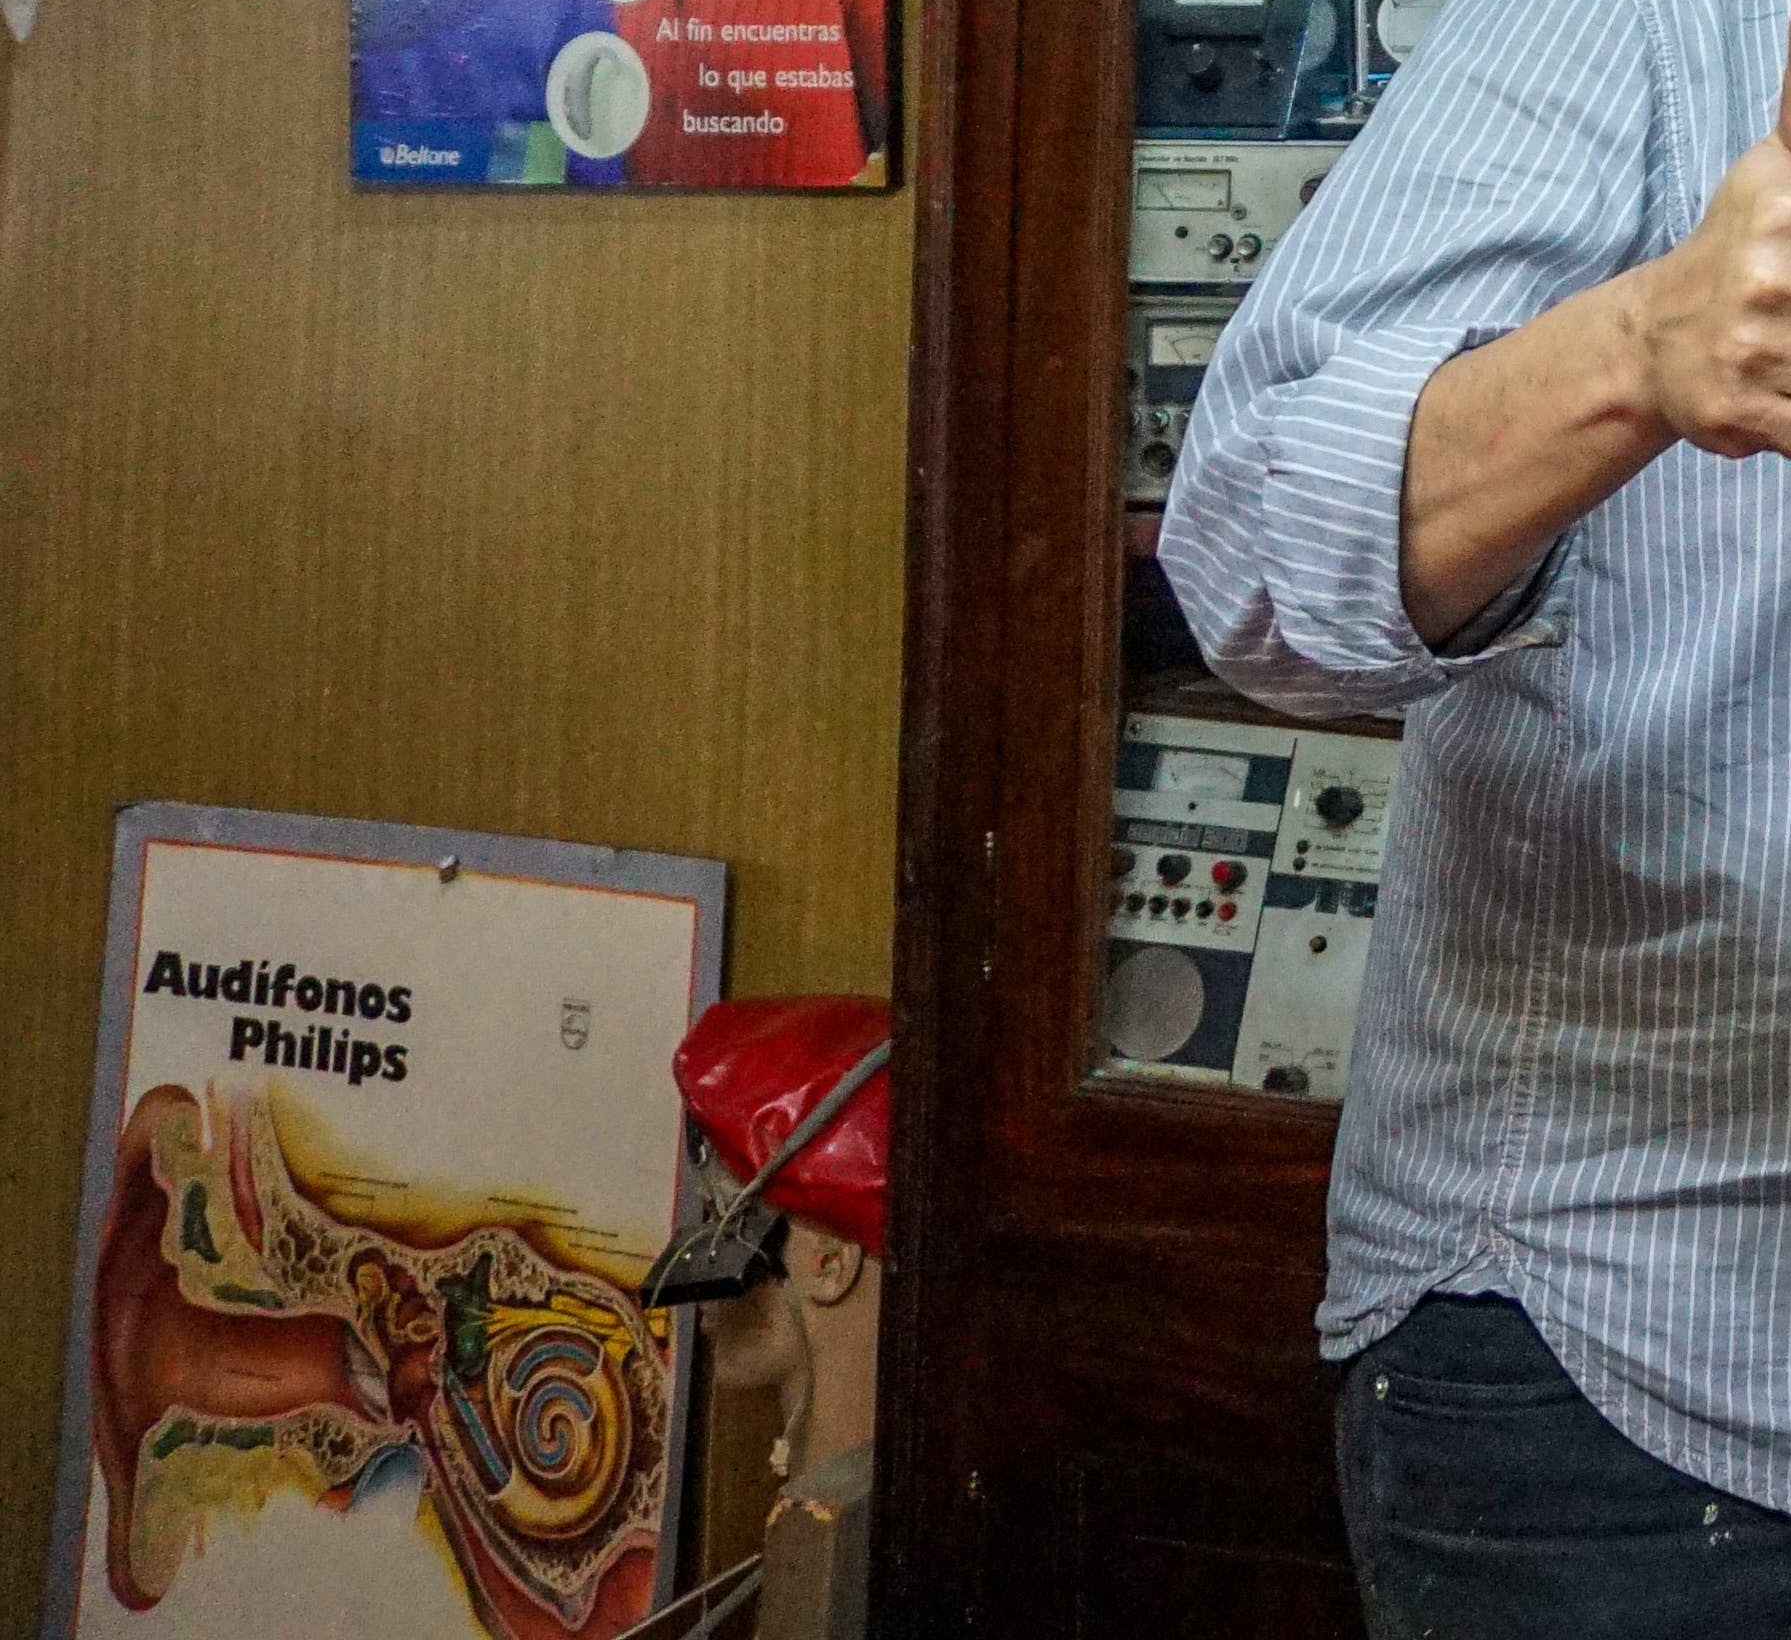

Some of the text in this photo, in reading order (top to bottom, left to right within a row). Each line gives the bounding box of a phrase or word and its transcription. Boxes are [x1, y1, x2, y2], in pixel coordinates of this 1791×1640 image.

[656, 17, 840, 43] Al fin encuentras
[699, 63, 855, 94] lo que estabas
[683, 109, 785, 135] buscando
[395, 143, 461, 166] Beltone
[143, 950, 413, 1024] Audífonos
[229, 1016, 410, 1086] Philips
